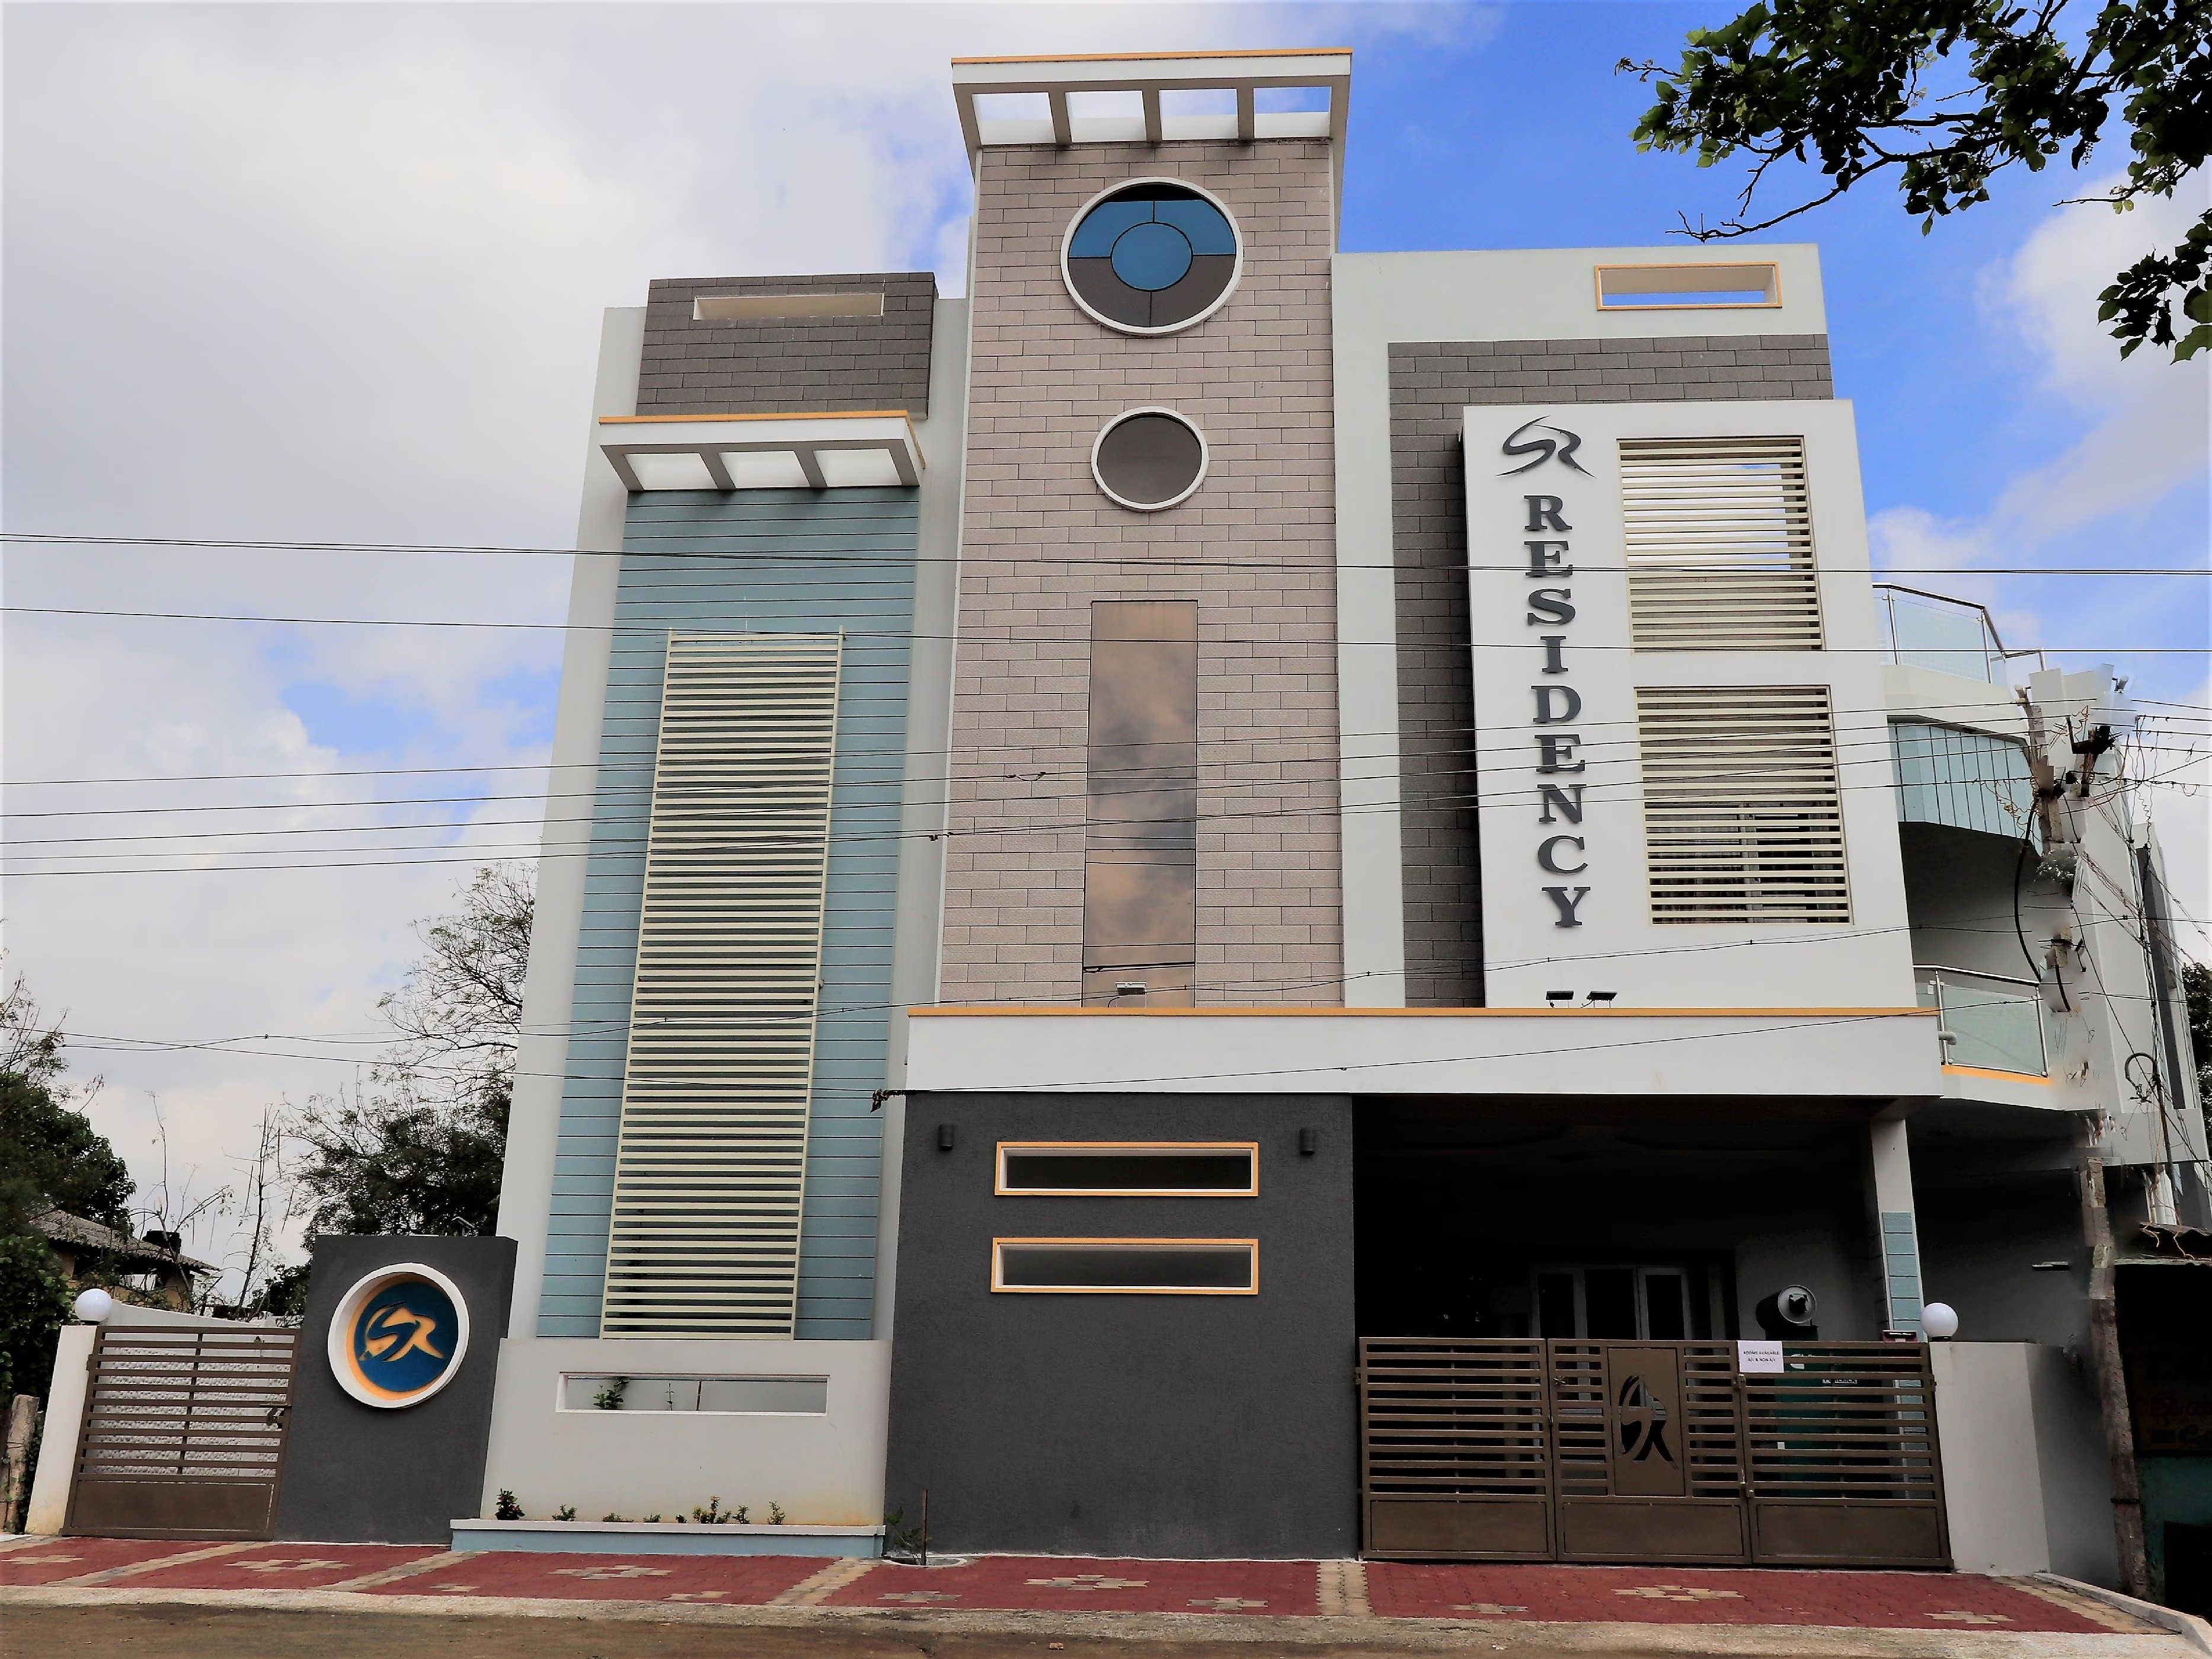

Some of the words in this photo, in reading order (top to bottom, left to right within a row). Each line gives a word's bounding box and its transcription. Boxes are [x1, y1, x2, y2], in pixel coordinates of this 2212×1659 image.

[1496, 415, 1596, 478] SR
[1523, 494, 1590, 928] RESIDENCY
[359, 1300, 446, 1361] SR
